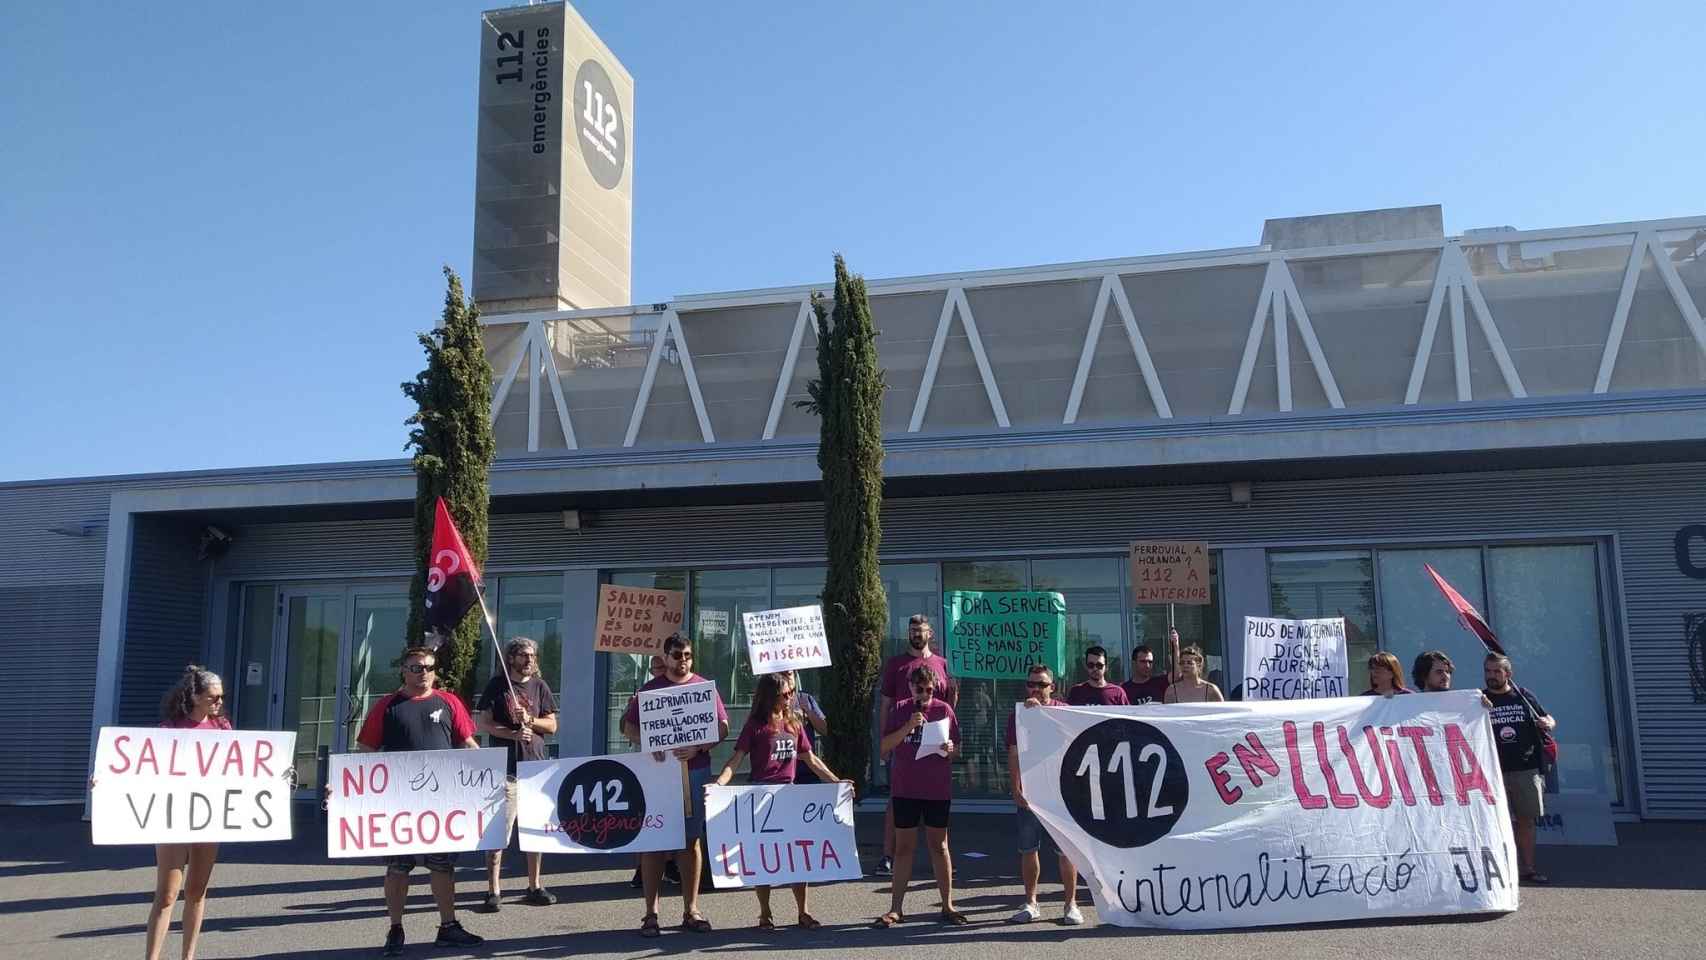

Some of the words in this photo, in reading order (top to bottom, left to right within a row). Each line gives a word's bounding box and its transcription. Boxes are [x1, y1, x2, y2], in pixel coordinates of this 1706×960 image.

[495, 30, 524, 85] 112
[530, 27, 552, 154] emergències
[583, 80, 617, 149] 112
[1134, 545, 1186, 555] FERROVIAL
[1194, 545, 1202, 554] A
[1138, 556, 1182, 565] HOLANDA
[1141, 567, 1173, 582] 112
[1187, 568, 1199, 580] A
[607, 590, 667, 608] SALVAR
[1137, 586, 1208, 600] INTERIOR
[606, 605, 652, 620] VIDES
[661, 611, 681, 625] NO
[950, 595, 994, 616] FORA
[999, 596, 1061, 616] SERVEIS
[603, 618, 624, 632] ÉS
[632, 622, 654, 633] UN
[748, 612, 781, 622] ATENEM
[809, 631, 824, 639] UNA
[953, 620, 1029, 639] ESSENCIALS
[1033, 622, 1049, 639] DE
[1247, 621, 1276, 638] PLUS
[1280, 624, 1294, 639] DE
[599, 633, 661, 649] NEGOCI
[958, 637, 981, 651] LES
[987, 640, 1023, 653] MANS
[1028, 641, 1045, 653] DE
[757, 644, 822, 663] MISÈRIA
[1245, 676, 1344, 700] PRECARIETAT
[641, 711, 714, 732] TREBALLADORES
[648, 727, 709, 748] PRECARIETAT
[775, 739, 794, 751] 112
[108, 735, 275, 778] SALVAR
[342, 763, 389, 797] NO
[408, 764, 440, 792] és
[457, 766, 500, 791] un
[1075, 741, 1175, 822] 112
[1204, 731, 1281, 806] EN
[570, 779, 630, 814] 112
[126, 789, 273, 831] VIDES
[734, 791, 785, 834] 112
[802, 801, 844, 825] en
[339, 810, 484, 850] NEGOCI
[721, 839, 842, 876] LLUITA
[1117, 845, 1417, 918] internalització
[1448, 842, 1513, 893] JA!
